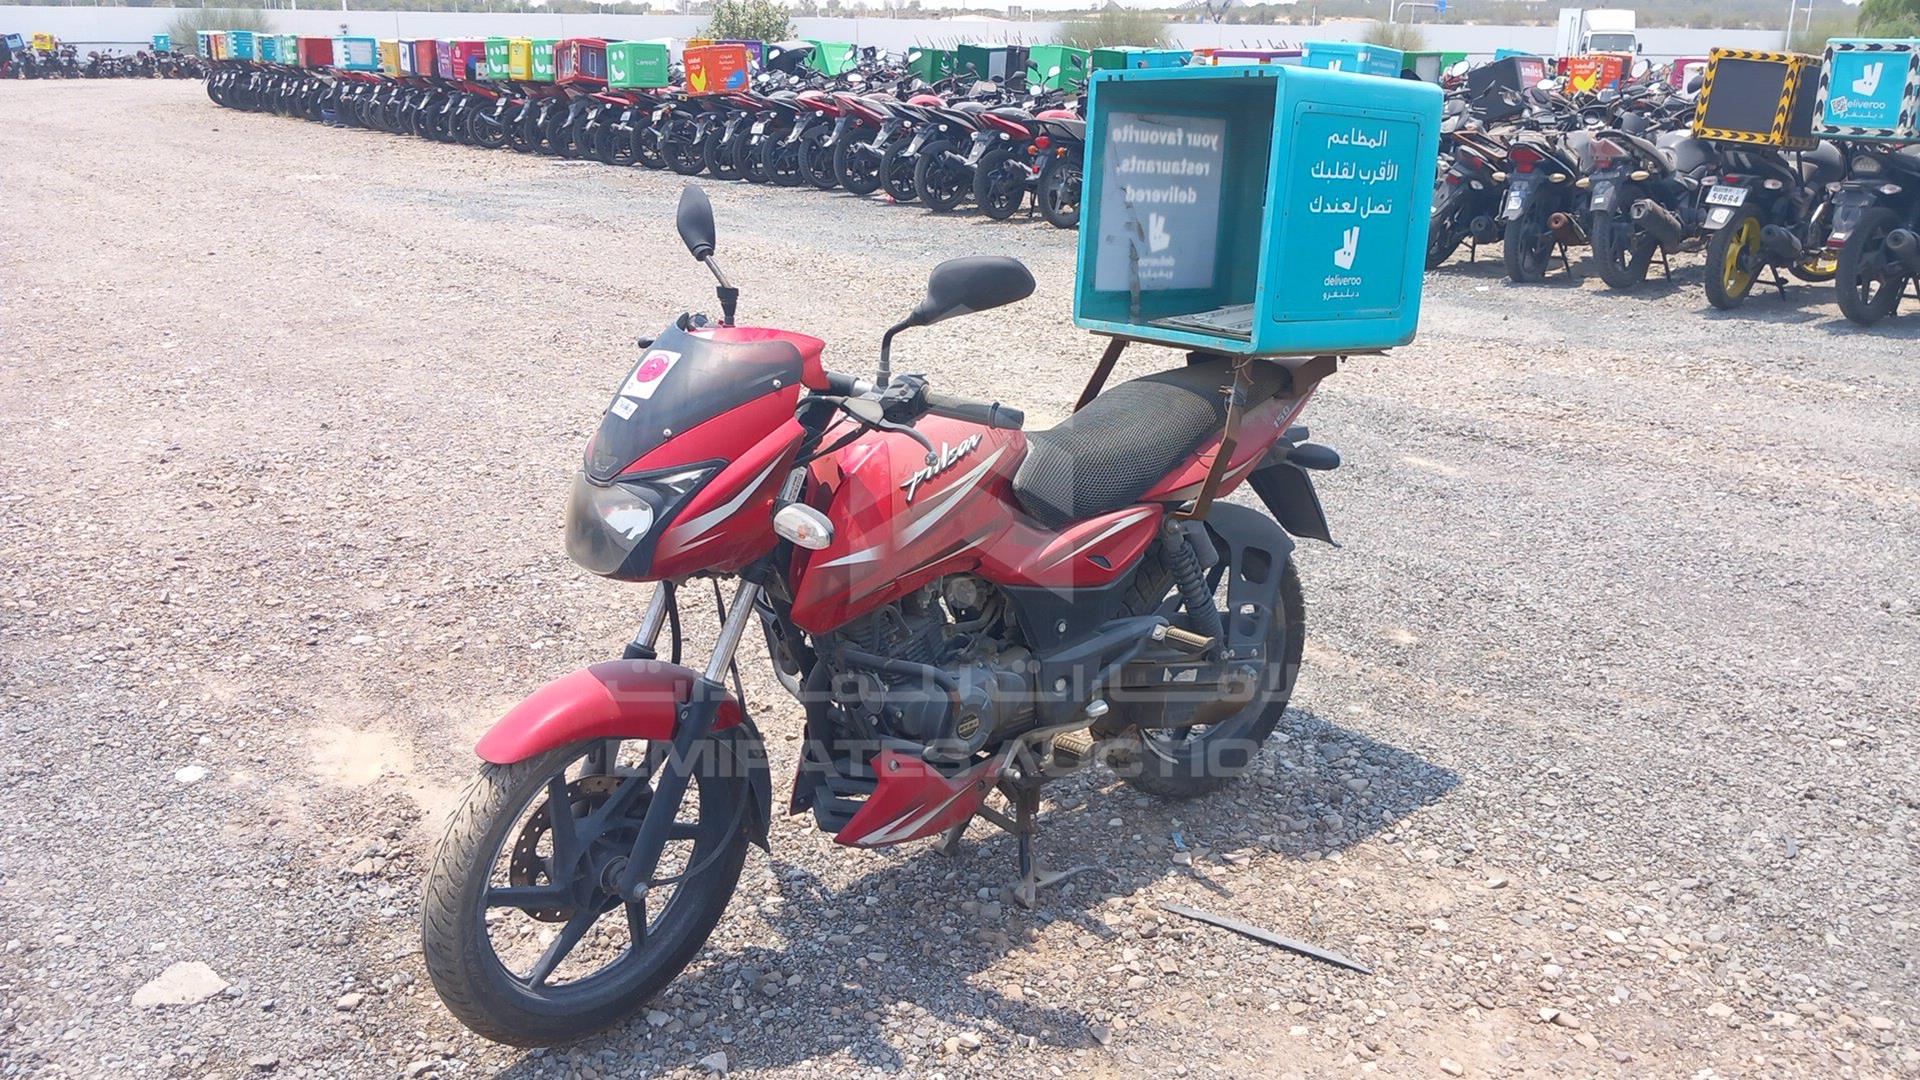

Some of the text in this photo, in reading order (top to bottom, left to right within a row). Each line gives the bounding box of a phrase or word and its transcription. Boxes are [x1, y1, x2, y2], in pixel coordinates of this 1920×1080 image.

[1327, 127, 1388, 149] المطاعم
[1311, 159, 1399, 185] الأقرب لقلبك
[1309, 195, 1393, 219] تصل لعندك
[1323, 274, 1362, 287] deliveroo
